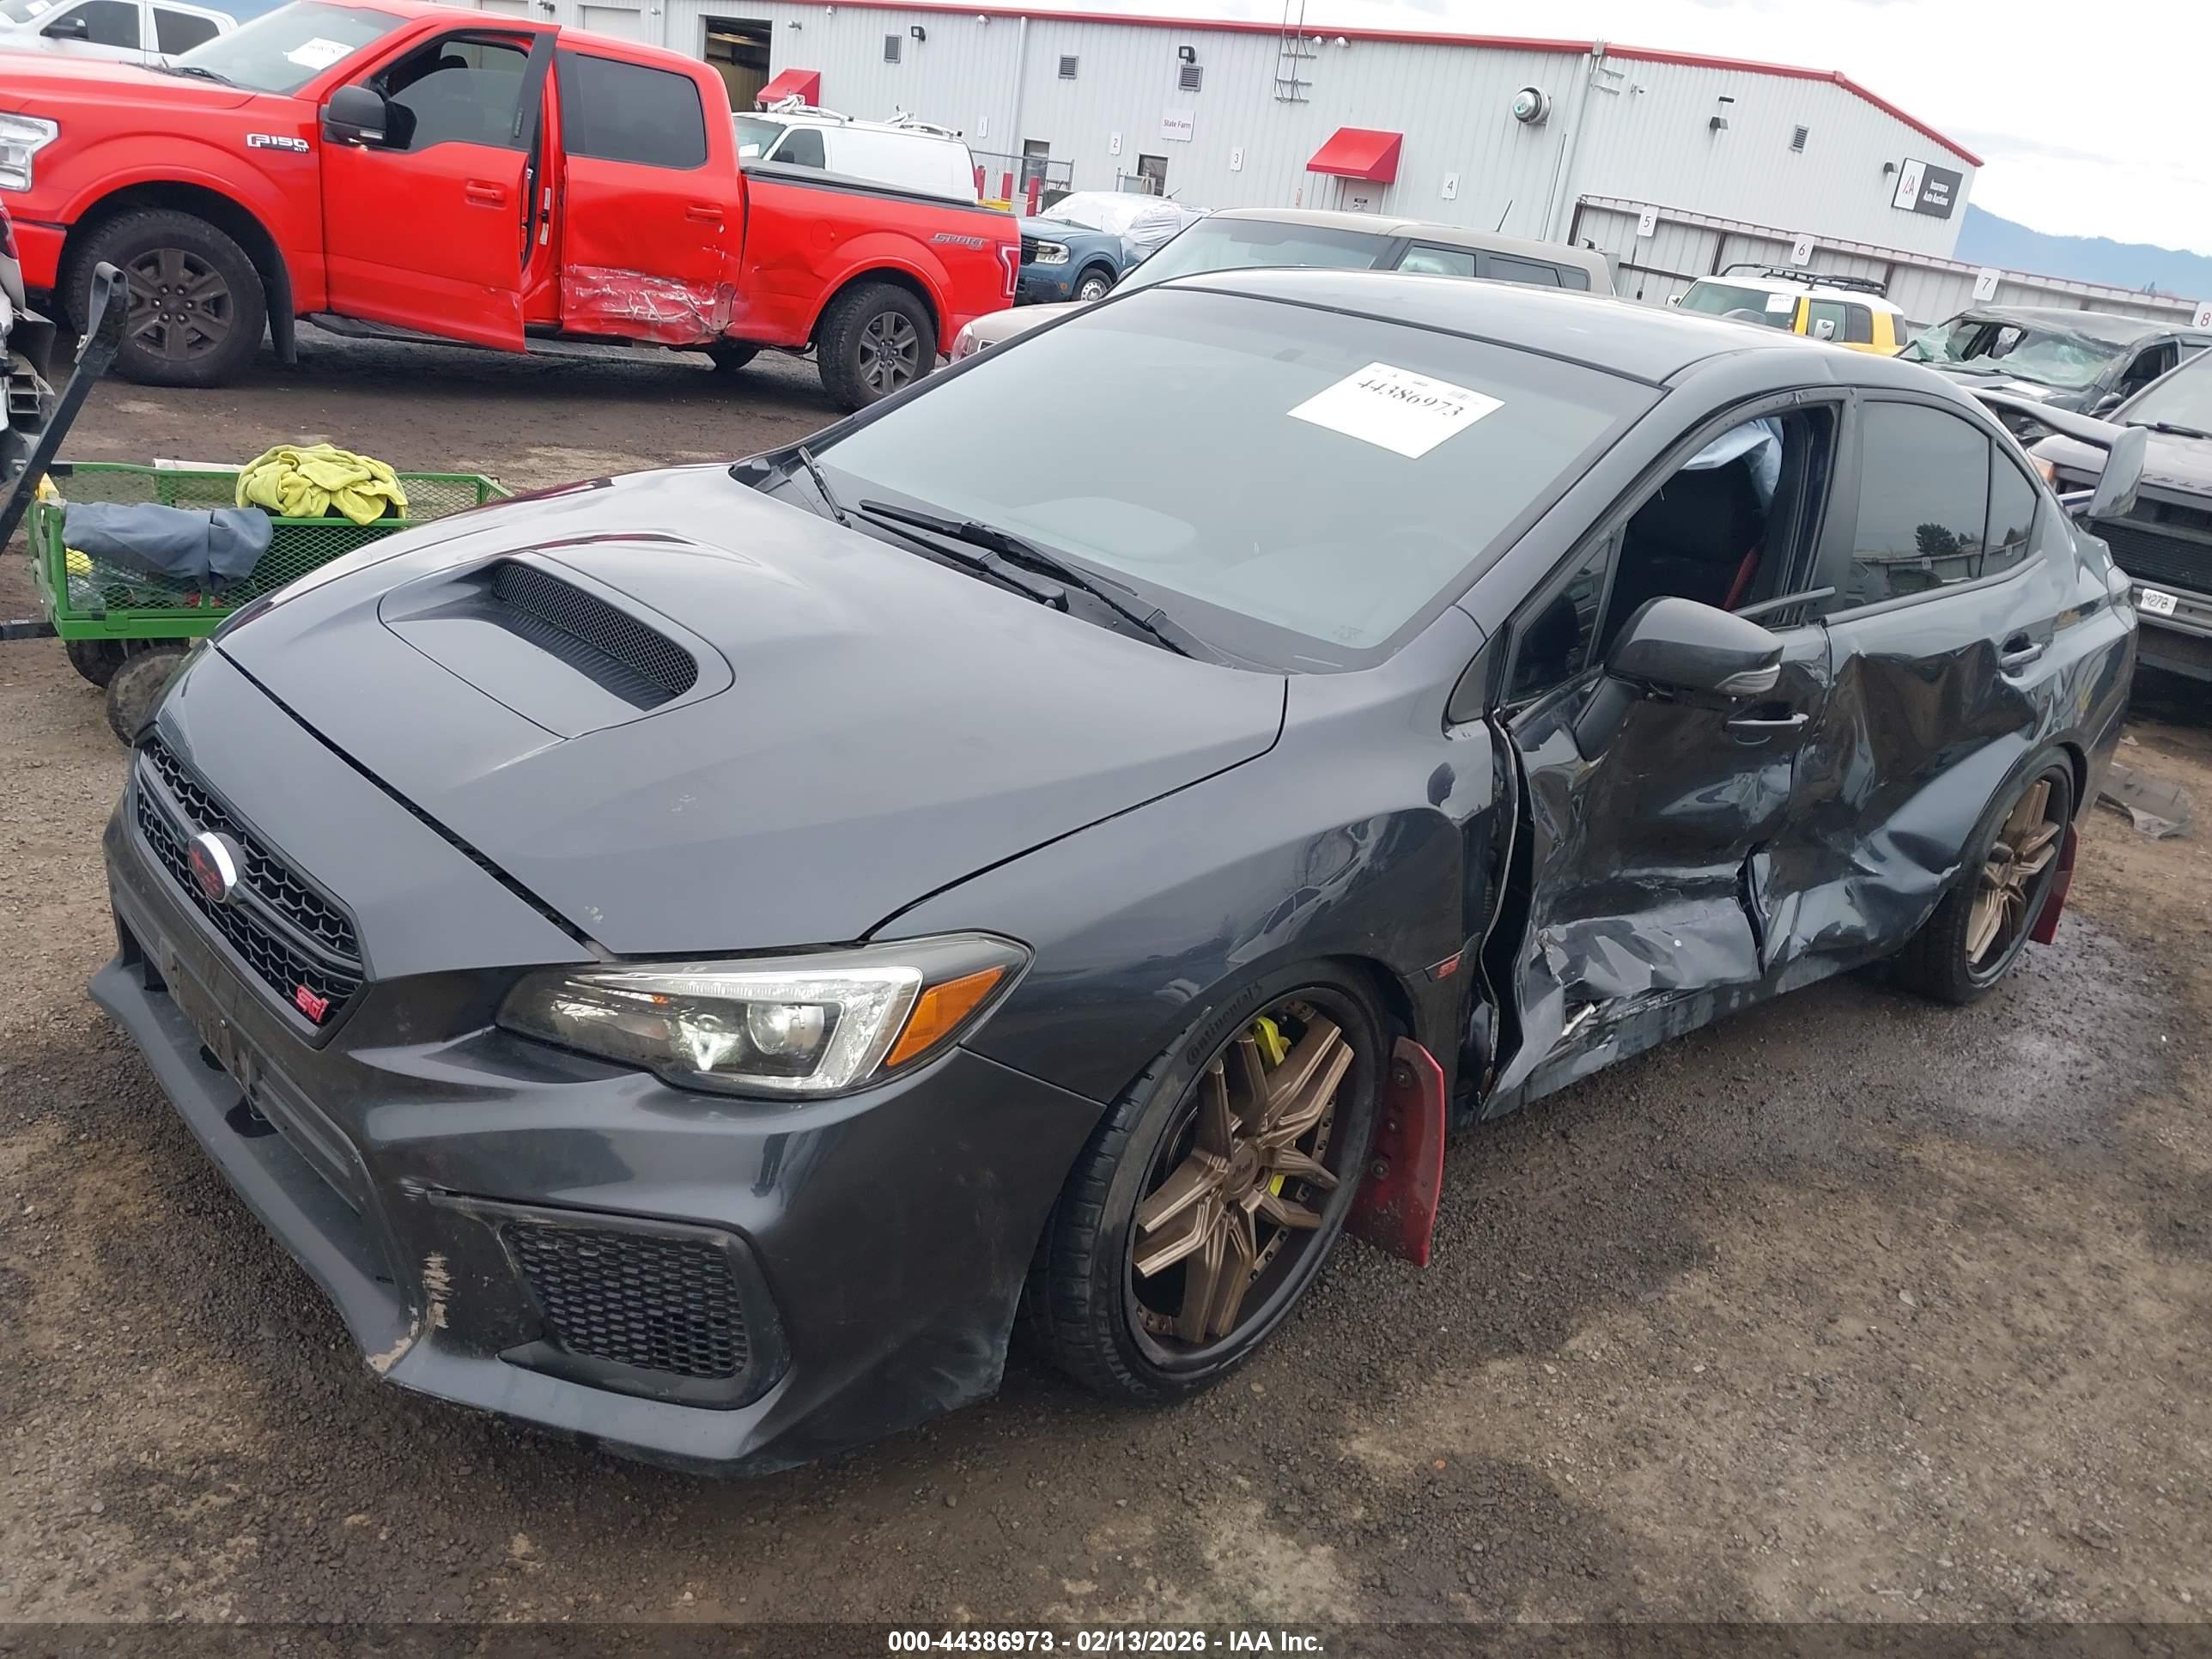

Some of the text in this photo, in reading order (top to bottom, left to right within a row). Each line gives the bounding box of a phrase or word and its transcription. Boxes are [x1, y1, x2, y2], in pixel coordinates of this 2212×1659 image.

[1163, 118, 1191, 129] State Farm
[1113, 137, 1119, 148] 2
[1234, 153, 1239, 164] 3
[1447, 179, 1454, 191] 4
[1644, 216, 1651, 228] 5
[1798, 243, 1806, 256] 6
[1982, 276, 1992, 292] 7
[2200, 312, 2212, 327] 8
[1357, 379, 1464, 417] 44386973
